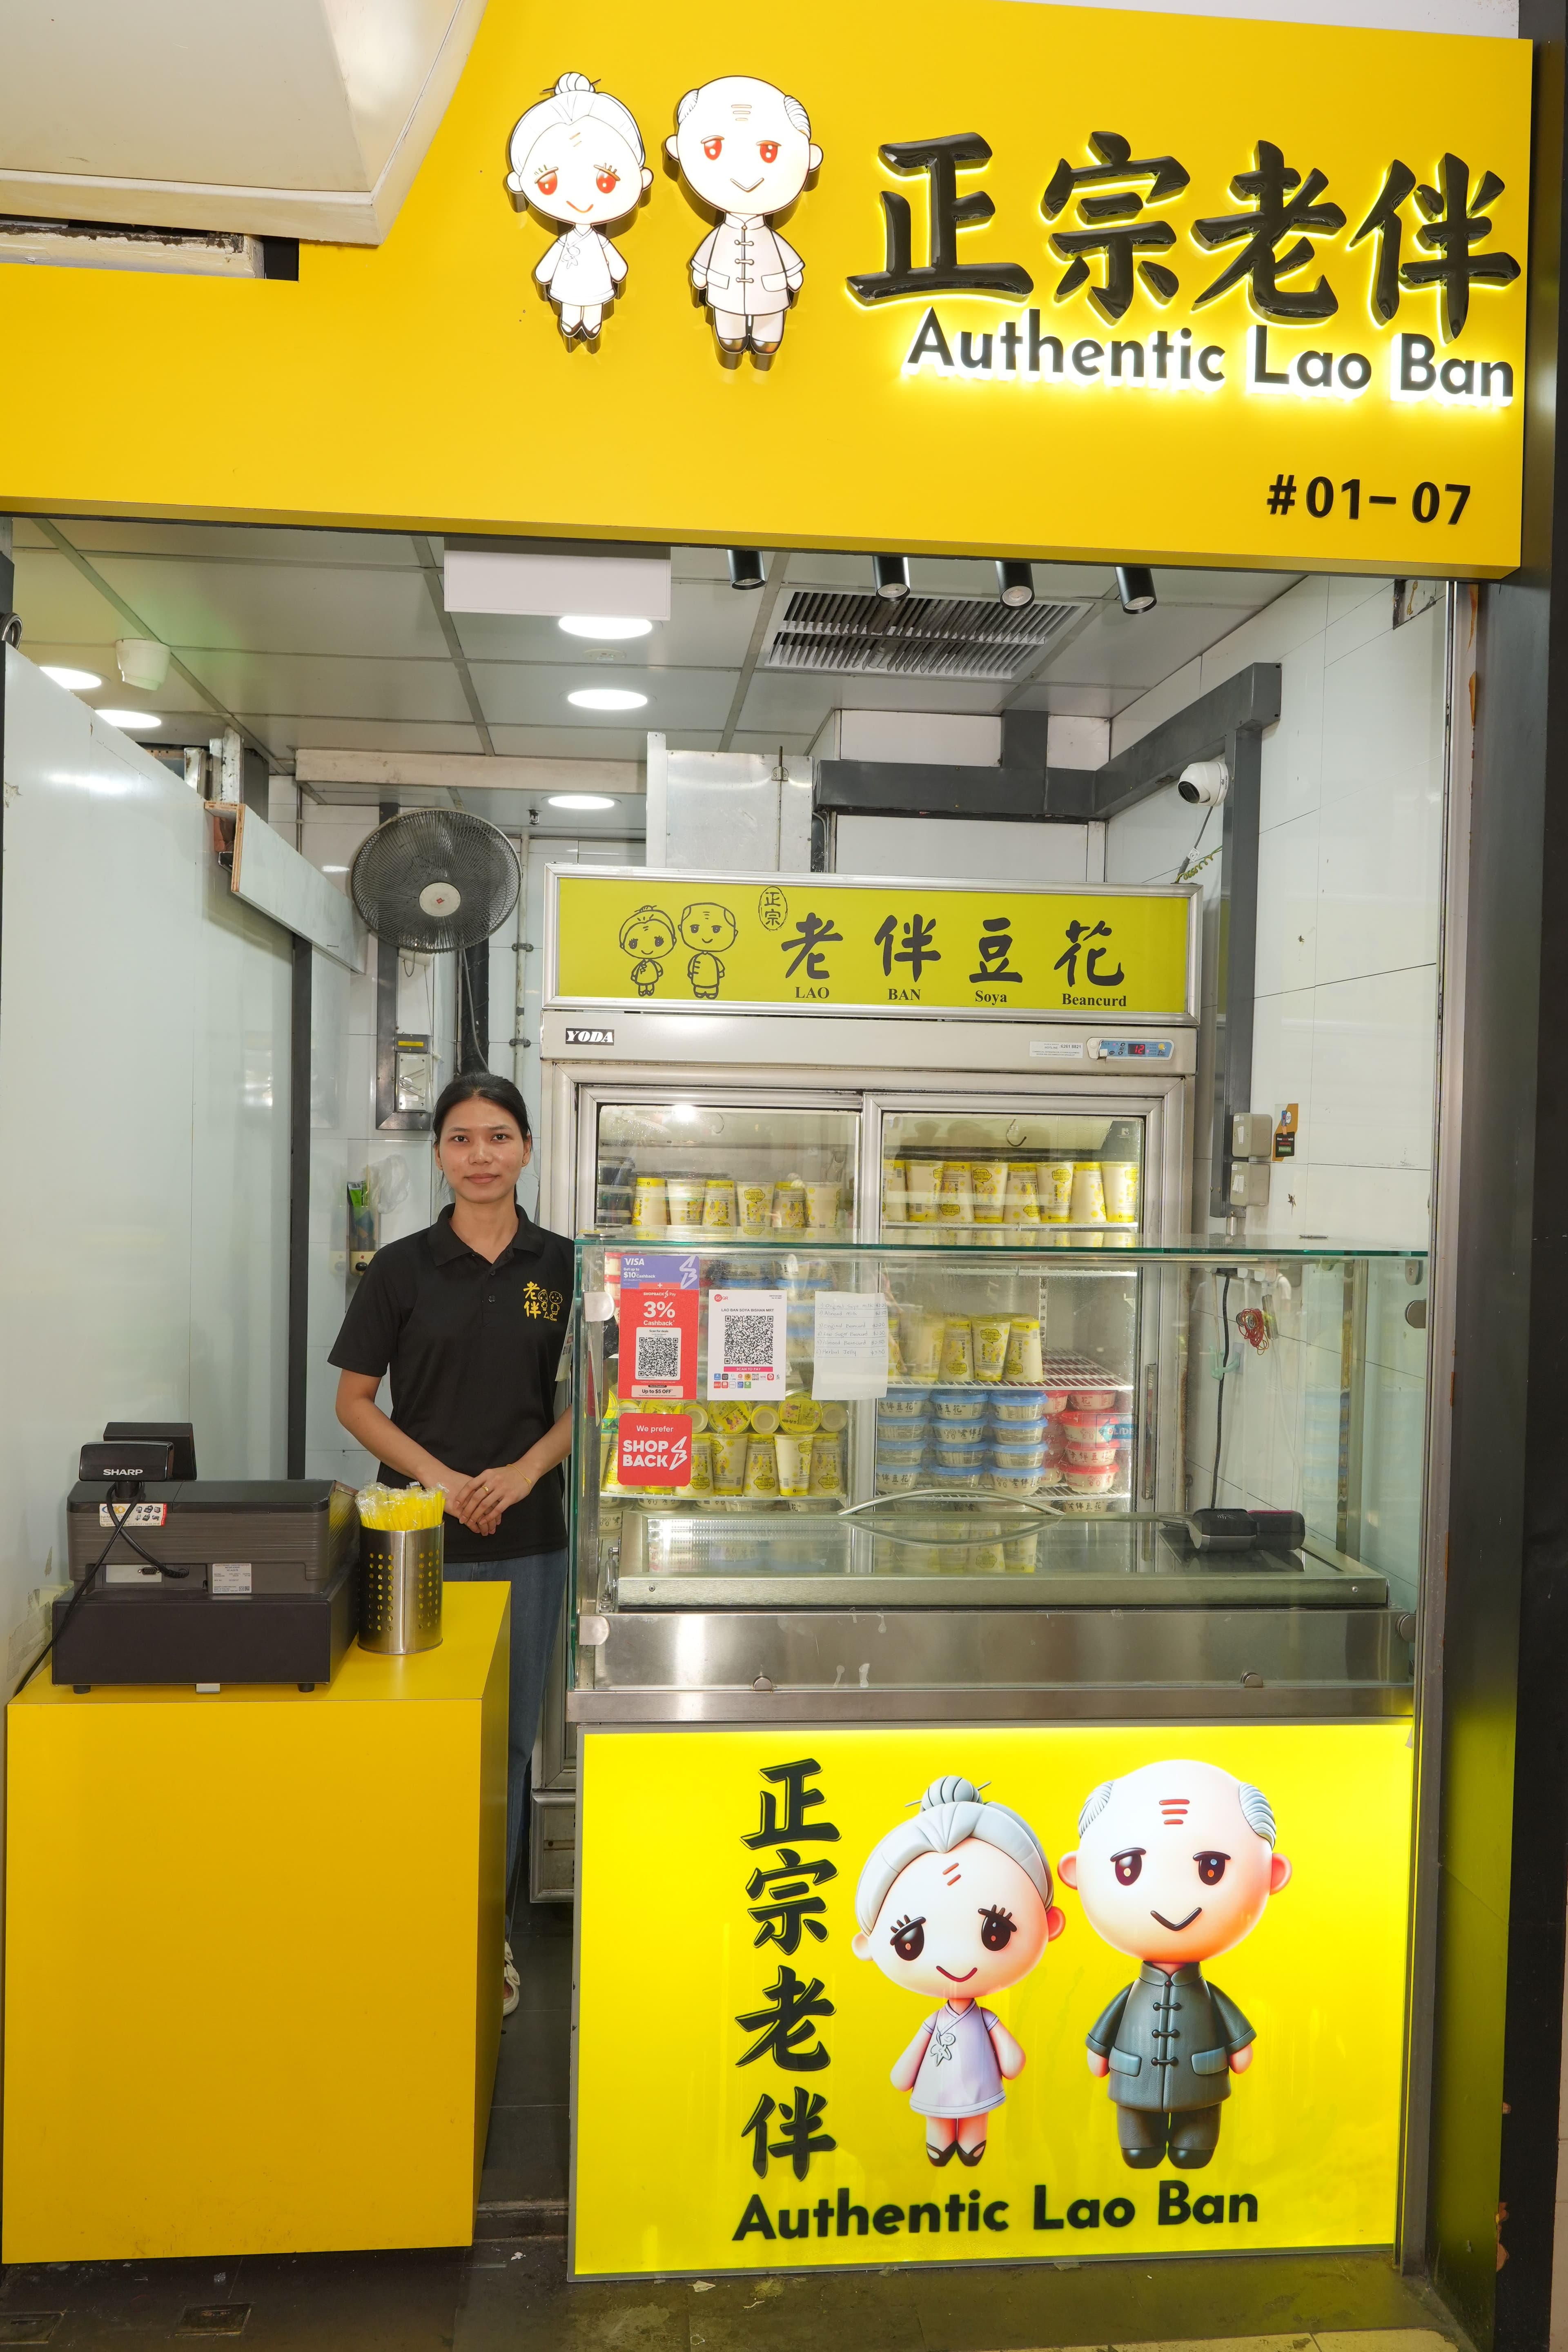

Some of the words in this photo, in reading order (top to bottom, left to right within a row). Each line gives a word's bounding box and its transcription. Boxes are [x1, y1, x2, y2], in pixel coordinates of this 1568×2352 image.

[845, 131, 1521, 341] 正宗老伴
[909, 307, 1225, 382] Authentic
[1255, 325, 1371, 392] Lao
[1400, 333, 1513, 397] Ban
[764, 892, 781, 926] 正宗
[781, 913, 1125, 987] 老伴豆花
[795, 987, 829, 999] LAO
[888, 989, 921, 1000] BAN
[975, 990, 1007, 1005] Soya
[1062, 993, 1127, 1007] Beancurd
[566, 1031, 613, 1042] YODA
[1134, 1045, 1145, 1054] 12
[523, 1281, 541, 1319] 老伴
[643, 1301, 675, 1318] 3%
[623, 1439, 669, 1452] SHOP
[623, 1454, 668, 1467] BACK
[735, 1758, 842, 2181] 正宗老伴
[732, 2187, 1009, 2241] Authentic
[1033, 2185, 1135, 2230] Lao
[1158, 2180, 1258, 2225] Ban
